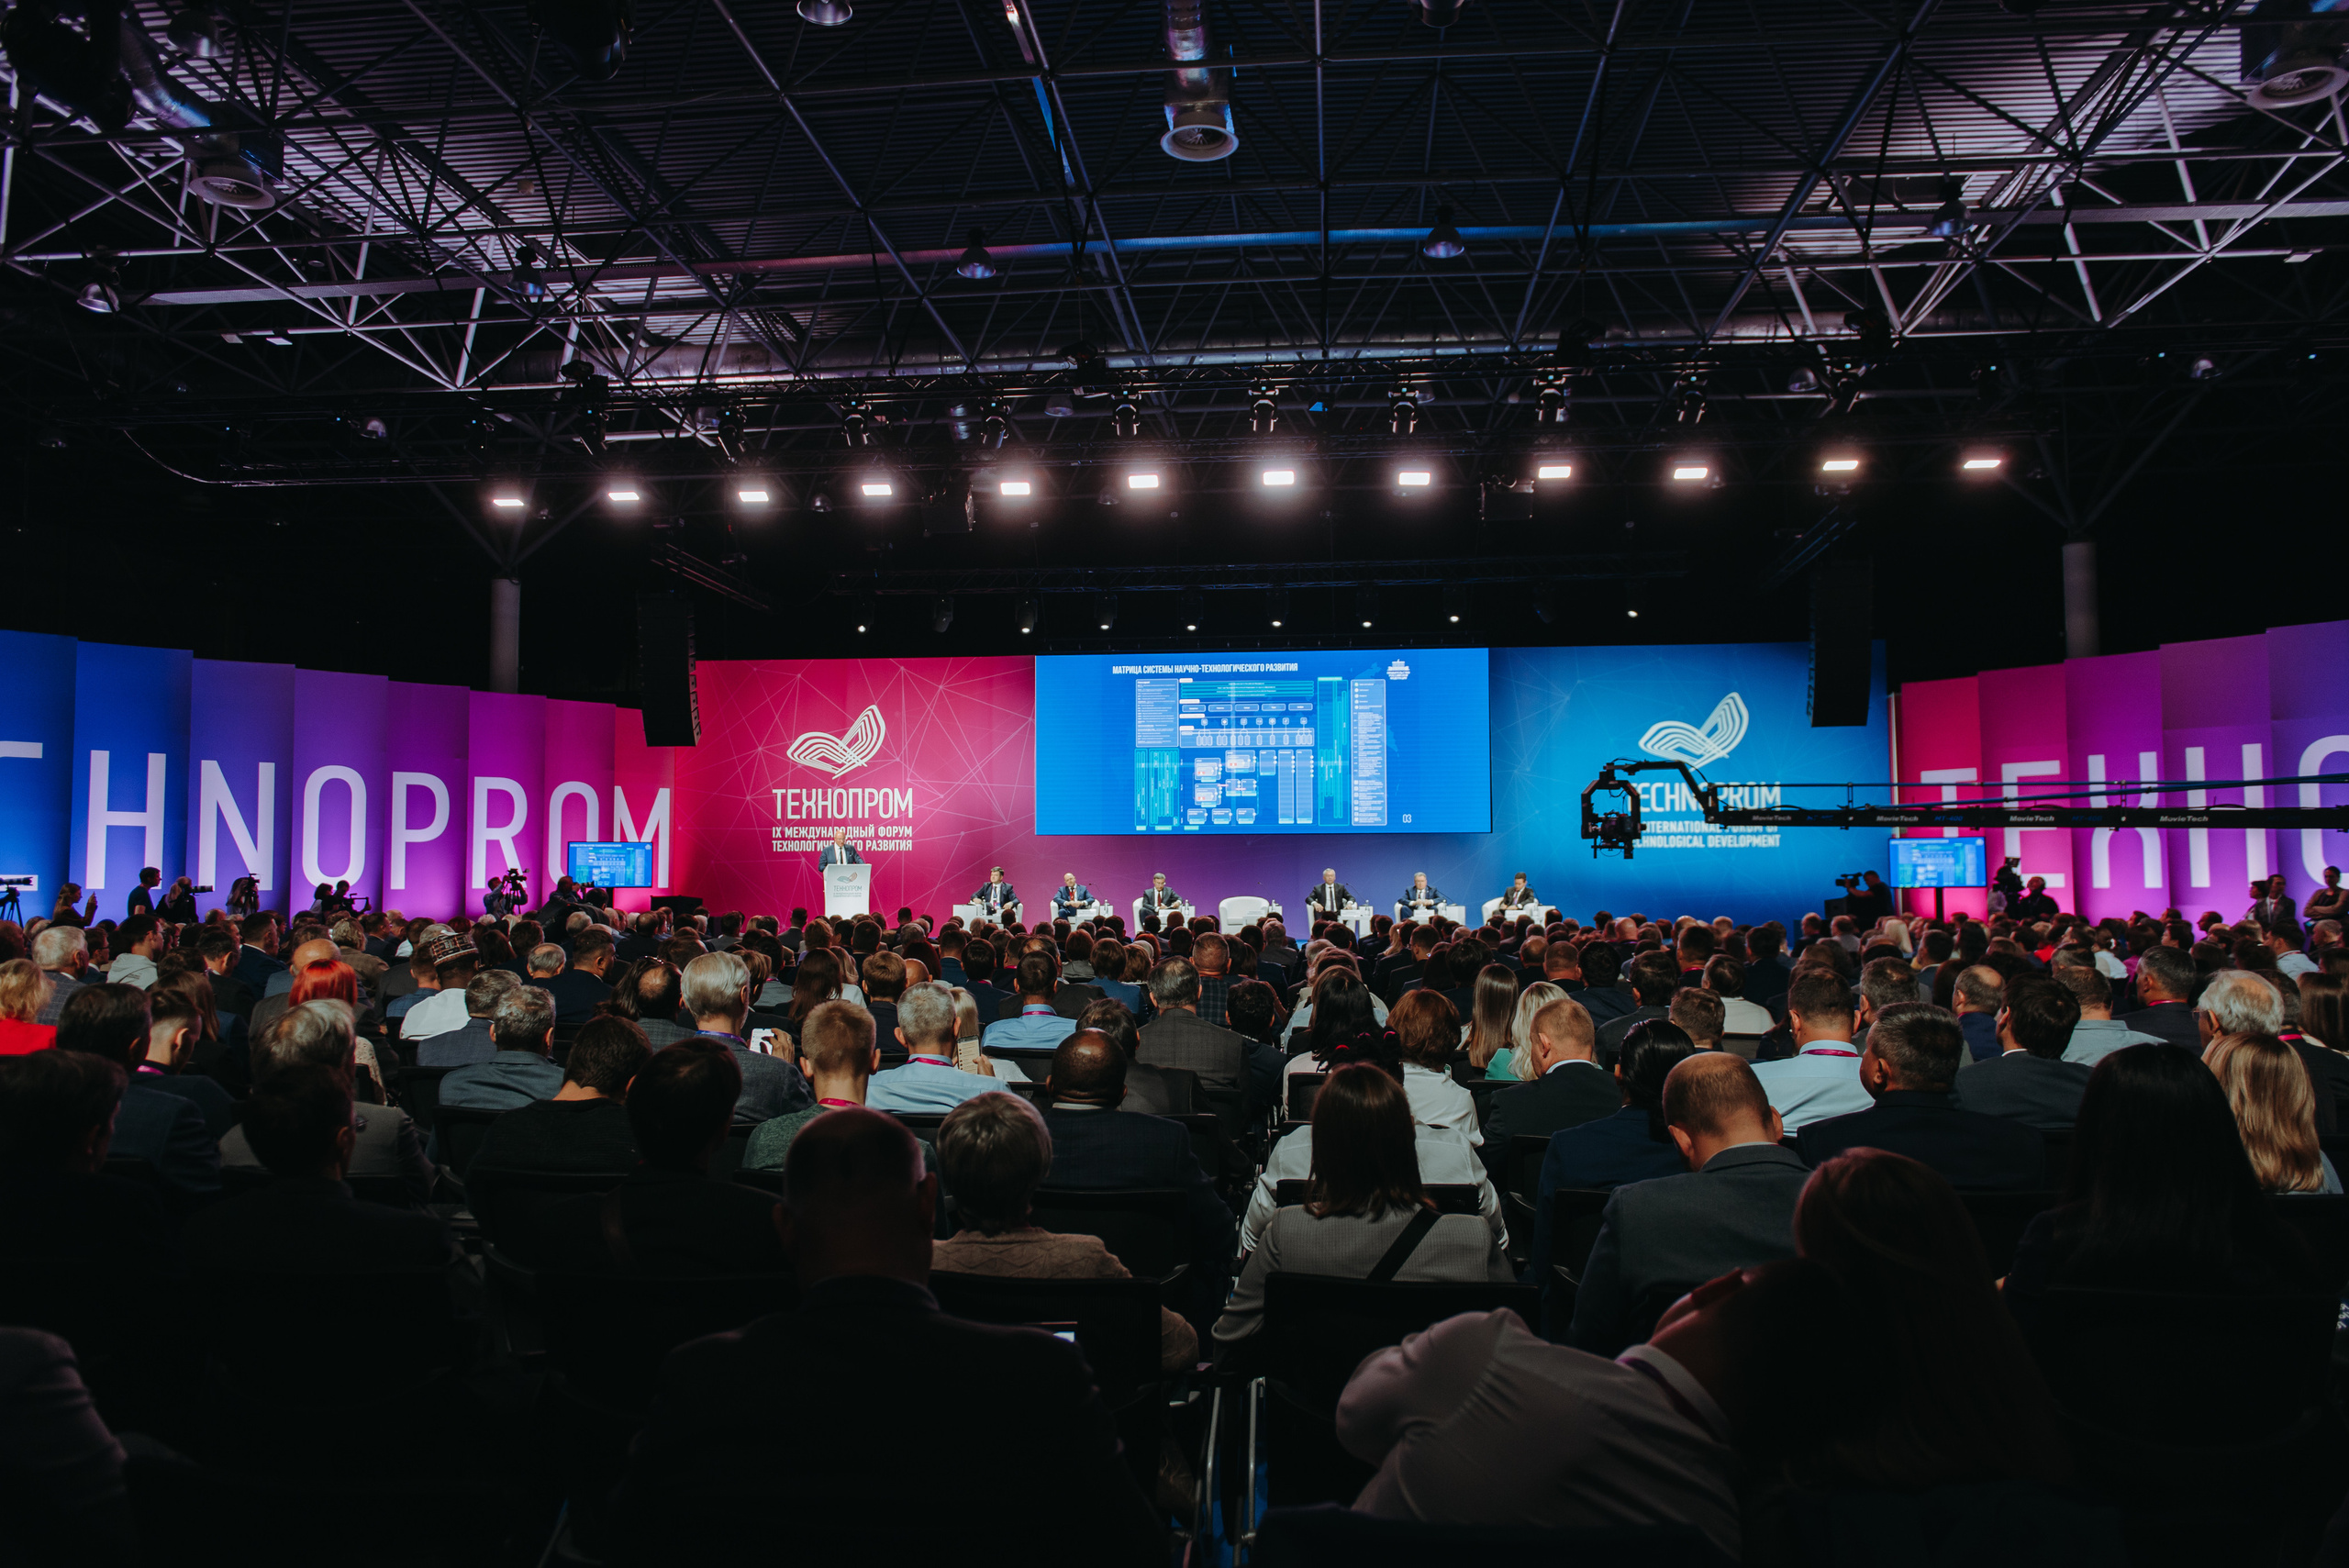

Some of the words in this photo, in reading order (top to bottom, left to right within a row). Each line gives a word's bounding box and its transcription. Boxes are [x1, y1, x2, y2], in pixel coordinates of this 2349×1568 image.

[1112, 665, 1142, 674] МАТРИЦА
[1143, 664, 1174, 673] СИСТЕМЫ
[1174, 663, 1264, 673] НАУЧНО-ТЕХНОЛОГИЧЕСКОГО
[1265, 662, 1298, 672] РАЗВИТИЯ
[772, 787, 913, 819] ТЕХНОПРОМ
[1402, 814, 1412, 823] 03
[772, 826, 782, 839] IX
[878, 826, 913, 838] ФОРУМ
[772, 840, 863, 852] ТЕХНОЛОГИЧГО
[866, 839, 913, 851] РАЗВИТИЯ
[1632, 835, 1706, 848] ECHNOLOGICAL
[1707, 834, 1782, 848] DEVELOPMENT
